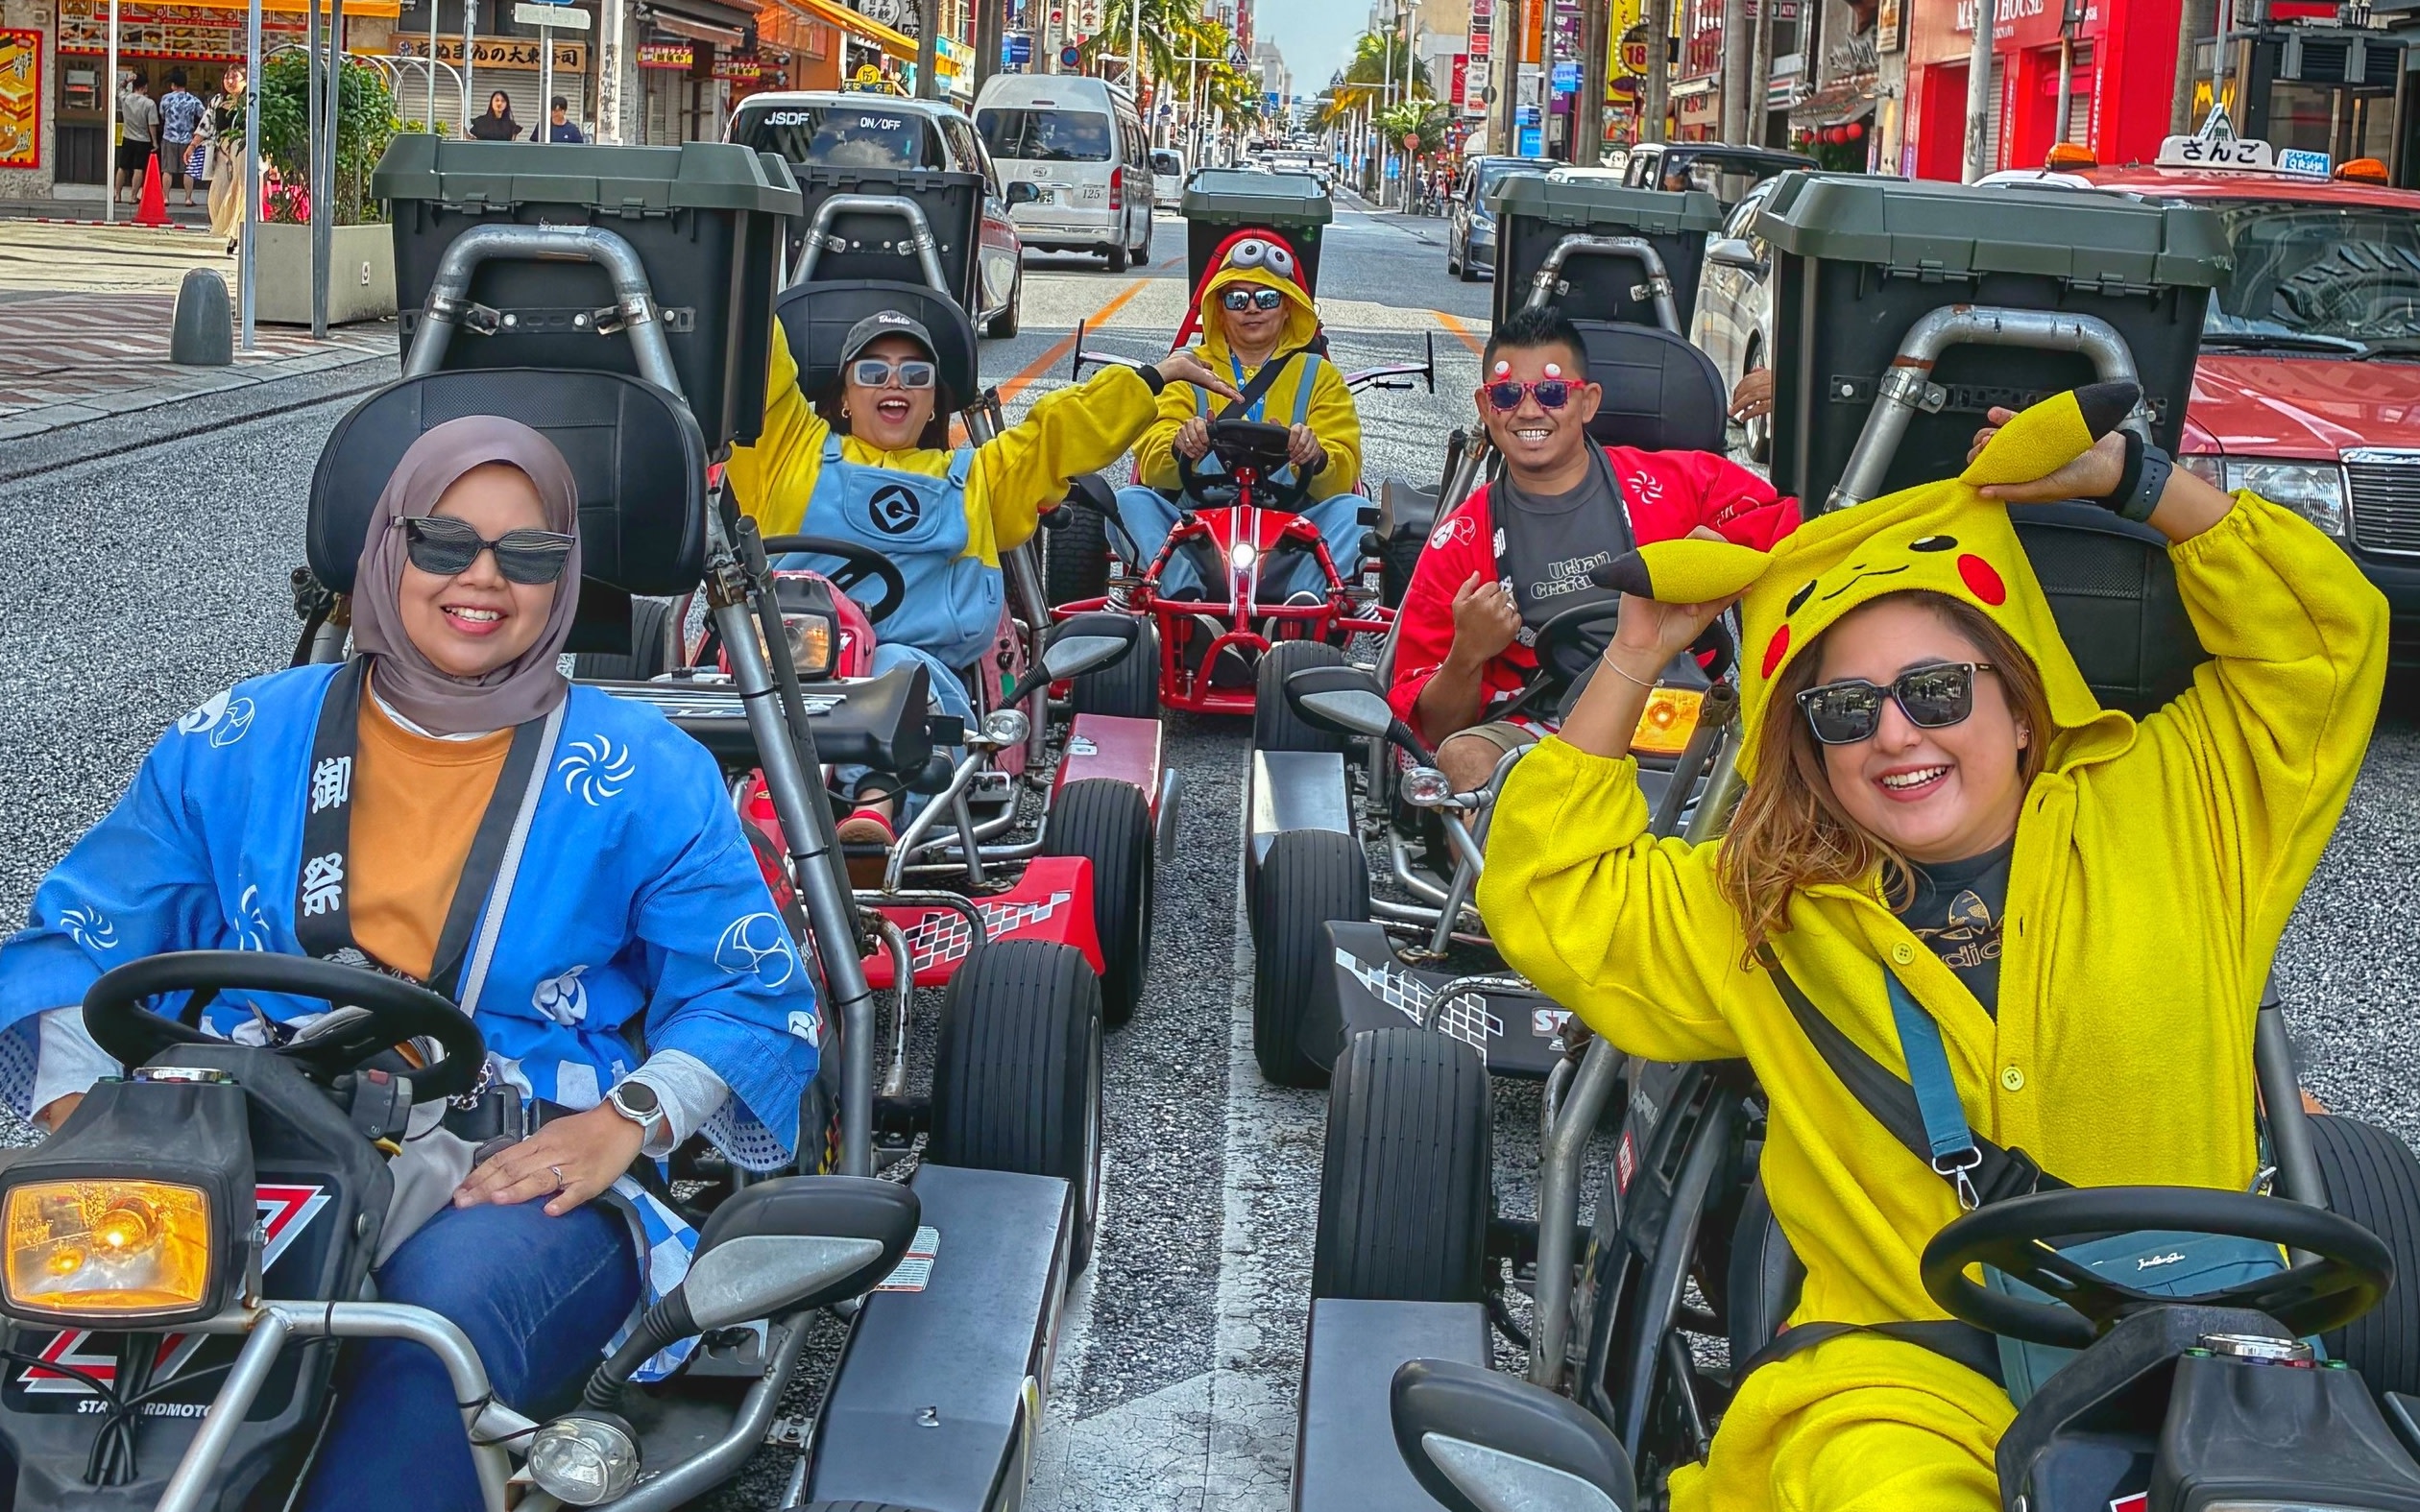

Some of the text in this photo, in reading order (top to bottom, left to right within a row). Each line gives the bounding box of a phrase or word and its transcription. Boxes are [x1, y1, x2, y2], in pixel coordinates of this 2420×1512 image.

[764, 111, 810, 126] JSDF
[859, 116, 902, 132] ON/OFF
[2182, 139, 2260, 164] さんご
[1082, 188, 1101, 200] 125
[302, 756, 351, 917] 御祭
